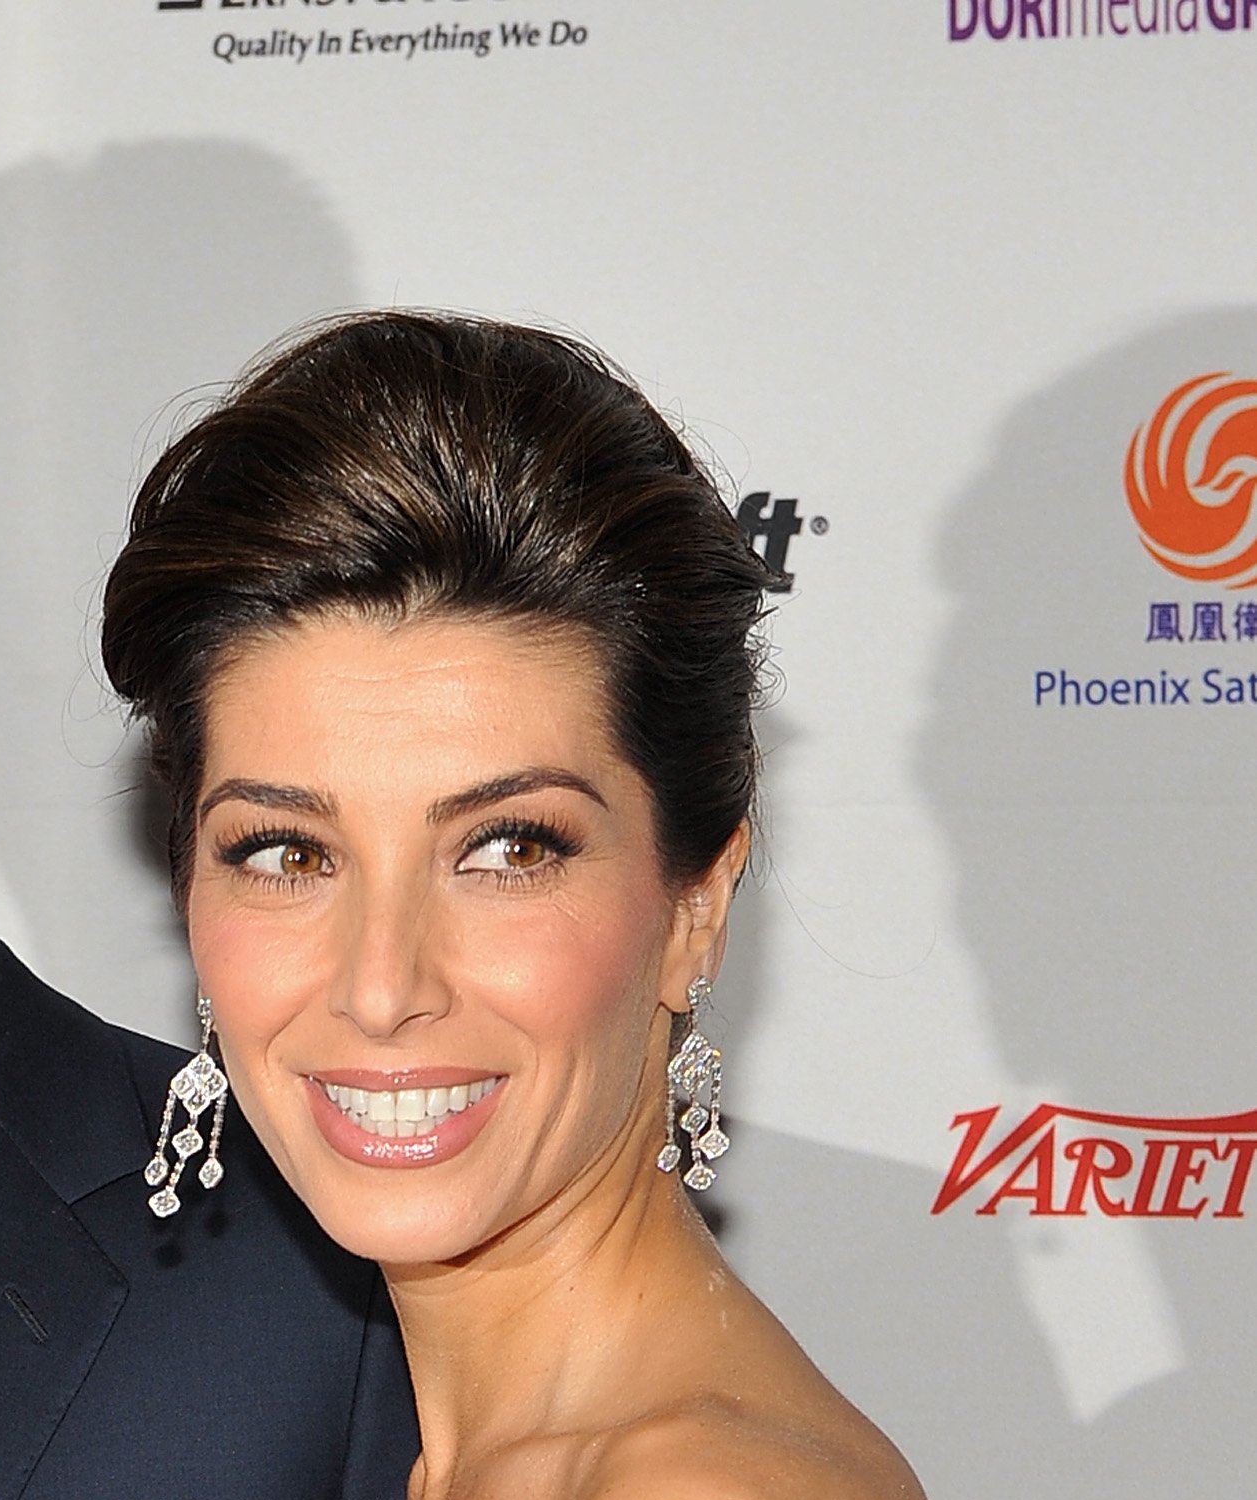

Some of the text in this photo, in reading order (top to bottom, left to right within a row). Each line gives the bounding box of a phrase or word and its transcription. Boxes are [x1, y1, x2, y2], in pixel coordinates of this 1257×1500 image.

[213, 21, 588, 63] Quality In Everything We Do
[1034, 669, 1257, 706] Phoenix Sat
